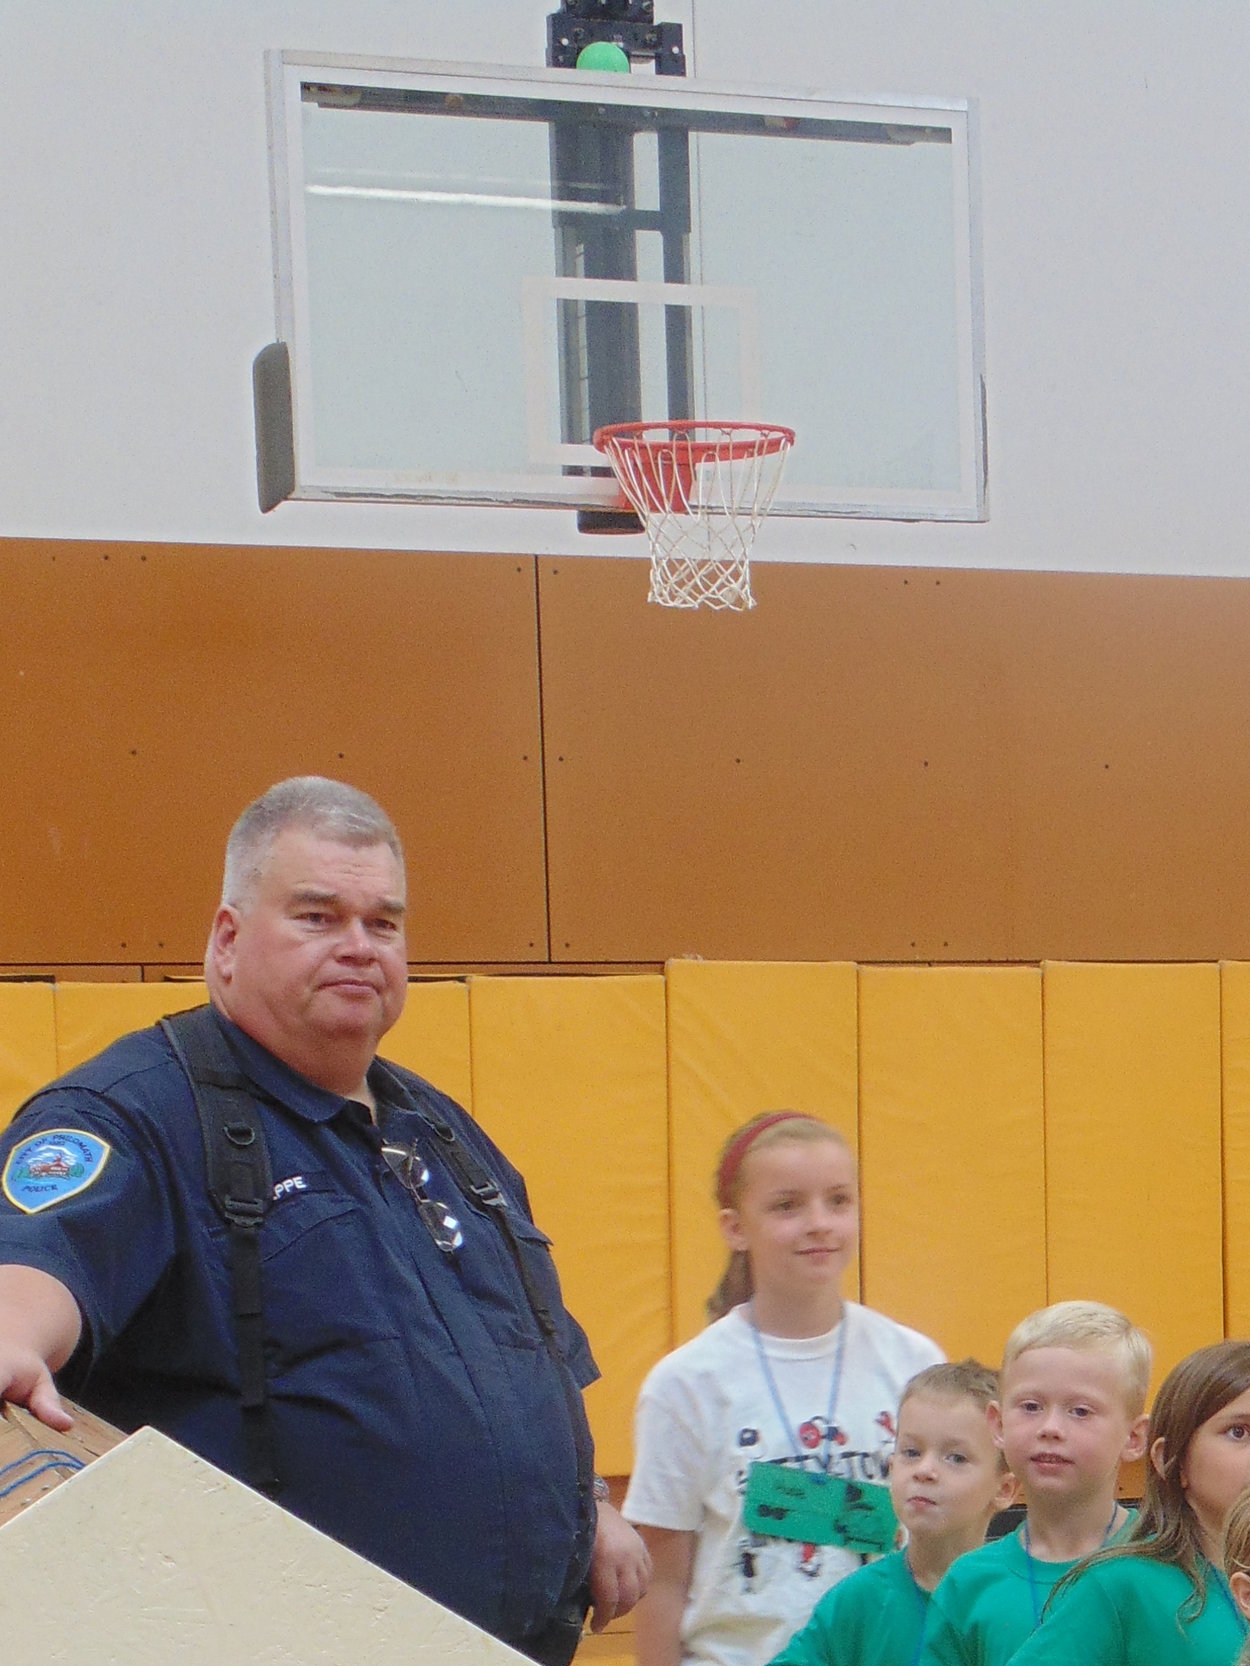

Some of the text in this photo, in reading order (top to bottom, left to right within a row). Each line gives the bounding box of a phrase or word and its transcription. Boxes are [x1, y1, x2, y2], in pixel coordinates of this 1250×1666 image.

[35, 1137, 48, 1147] OF
[53, 1134, 93, 1163] PHILOMATH
[22, 1184, 59, 1193] POLICE
[273, 1176, 308, 1200] PPE
